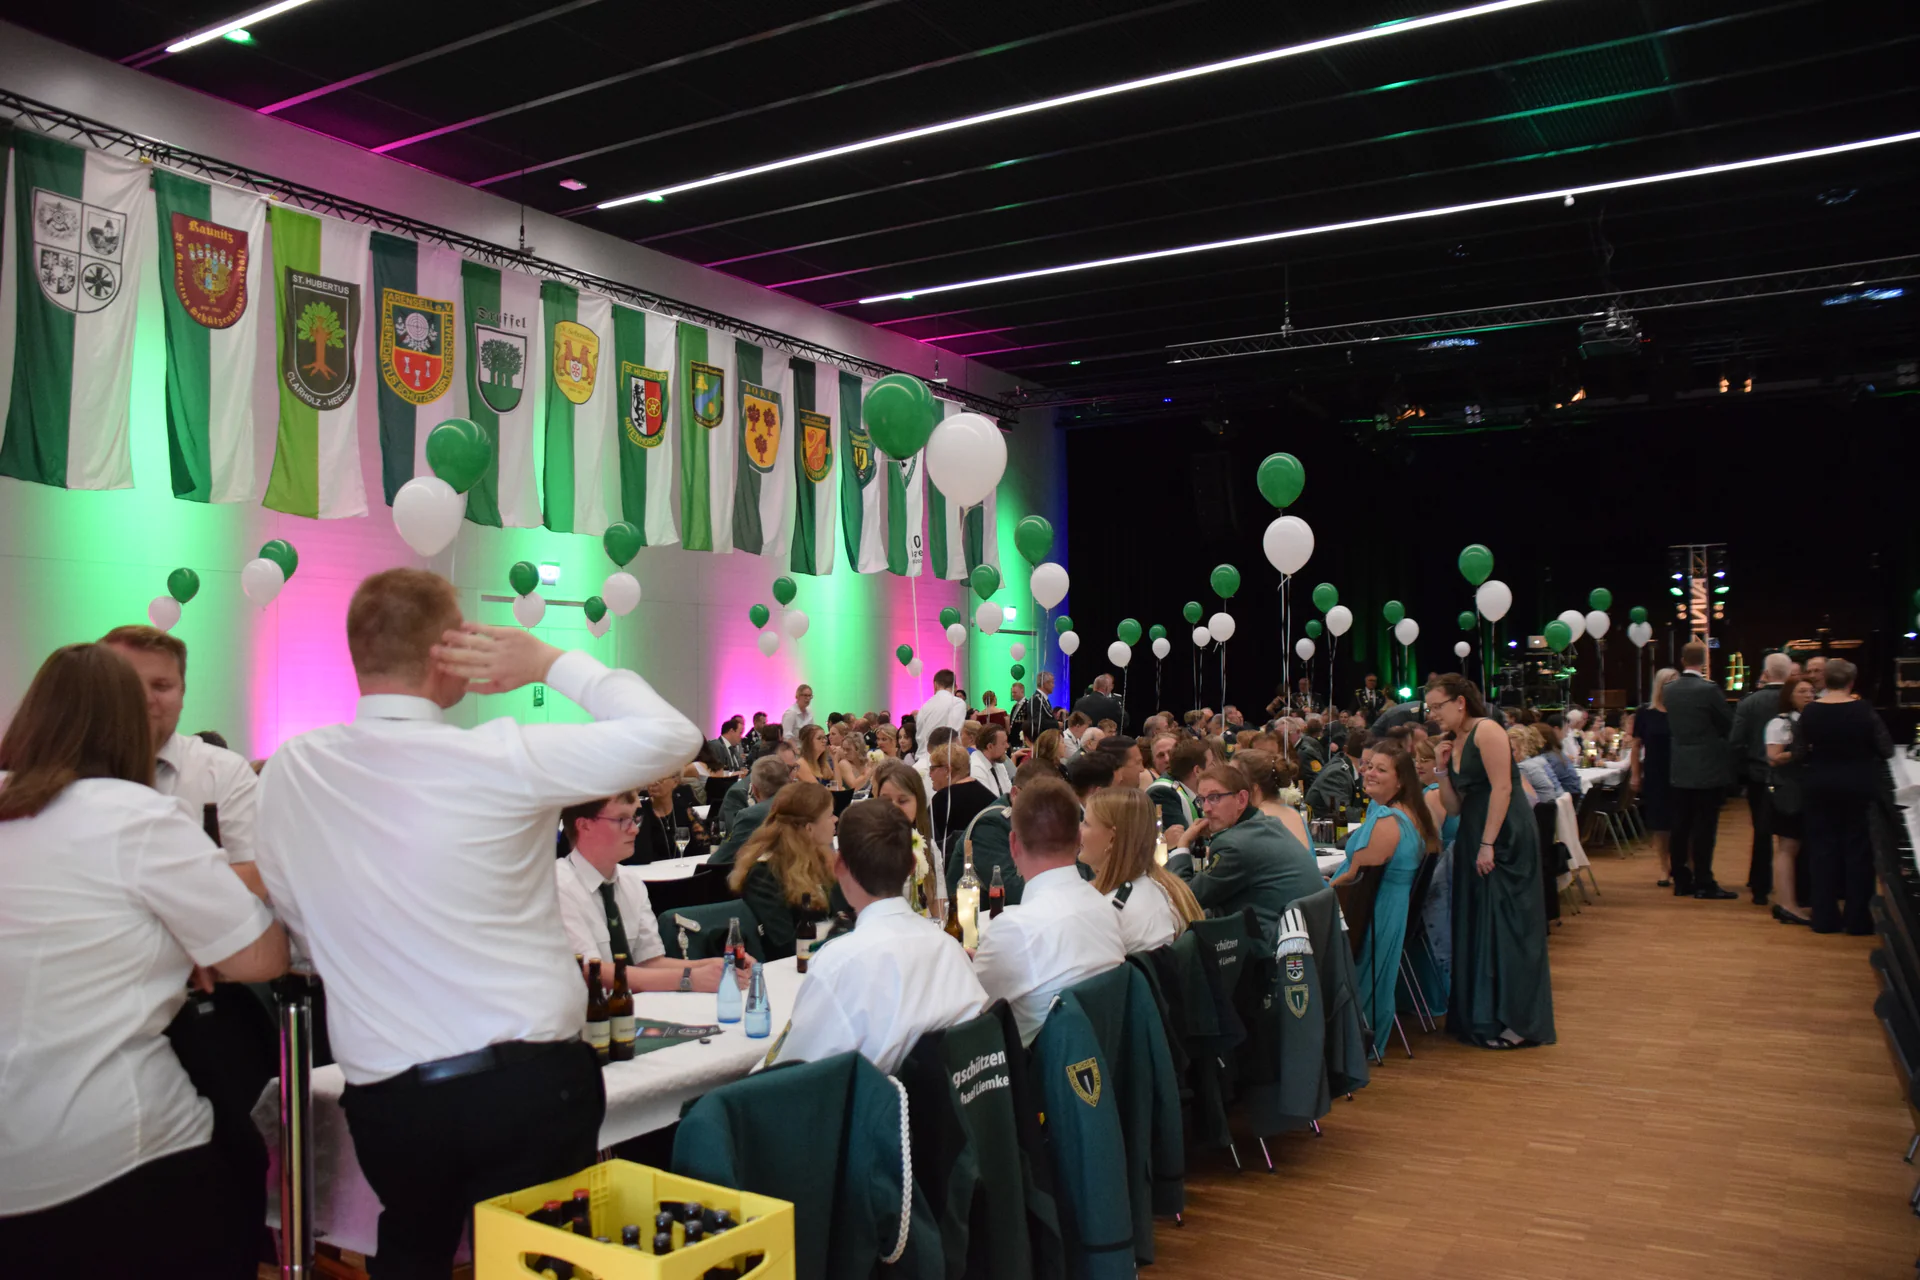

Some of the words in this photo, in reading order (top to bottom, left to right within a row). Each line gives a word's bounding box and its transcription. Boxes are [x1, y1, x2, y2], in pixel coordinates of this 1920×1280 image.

[188, 220, 234, 244] Kaunitz
[292, 274, 305, 285] ST.
[306, 276, 350, 295] HUBERTUS
[634, 368, 667, 381] HUBERTUS
[287, 371, 322, 407] CLARHOLZ
[1214, 938, 1238, 952] chützen
[952, 1050, 1006, 1089] gschützen
[976, 1074, 1010, 1096] Liemke
